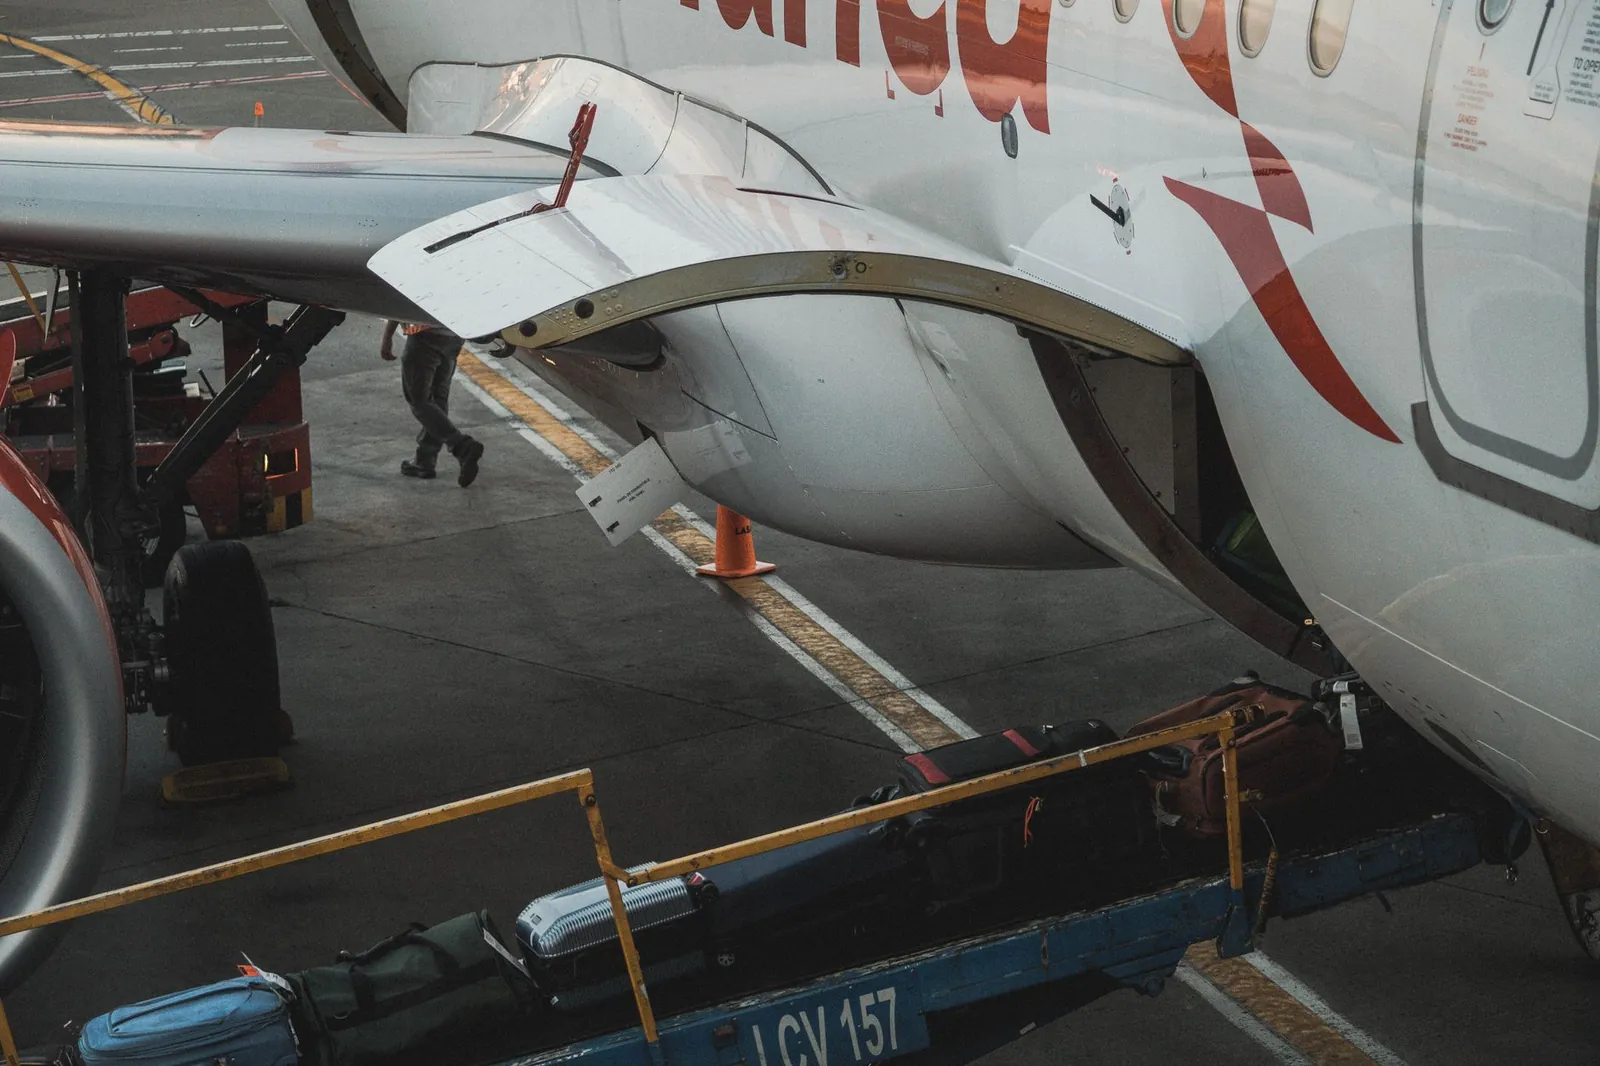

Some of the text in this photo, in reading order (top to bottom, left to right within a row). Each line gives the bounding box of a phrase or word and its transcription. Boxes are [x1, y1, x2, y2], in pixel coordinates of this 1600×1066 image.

[1573, 57, 1600, 73] TO OPE
[840, 987, 897, 1061] 157
